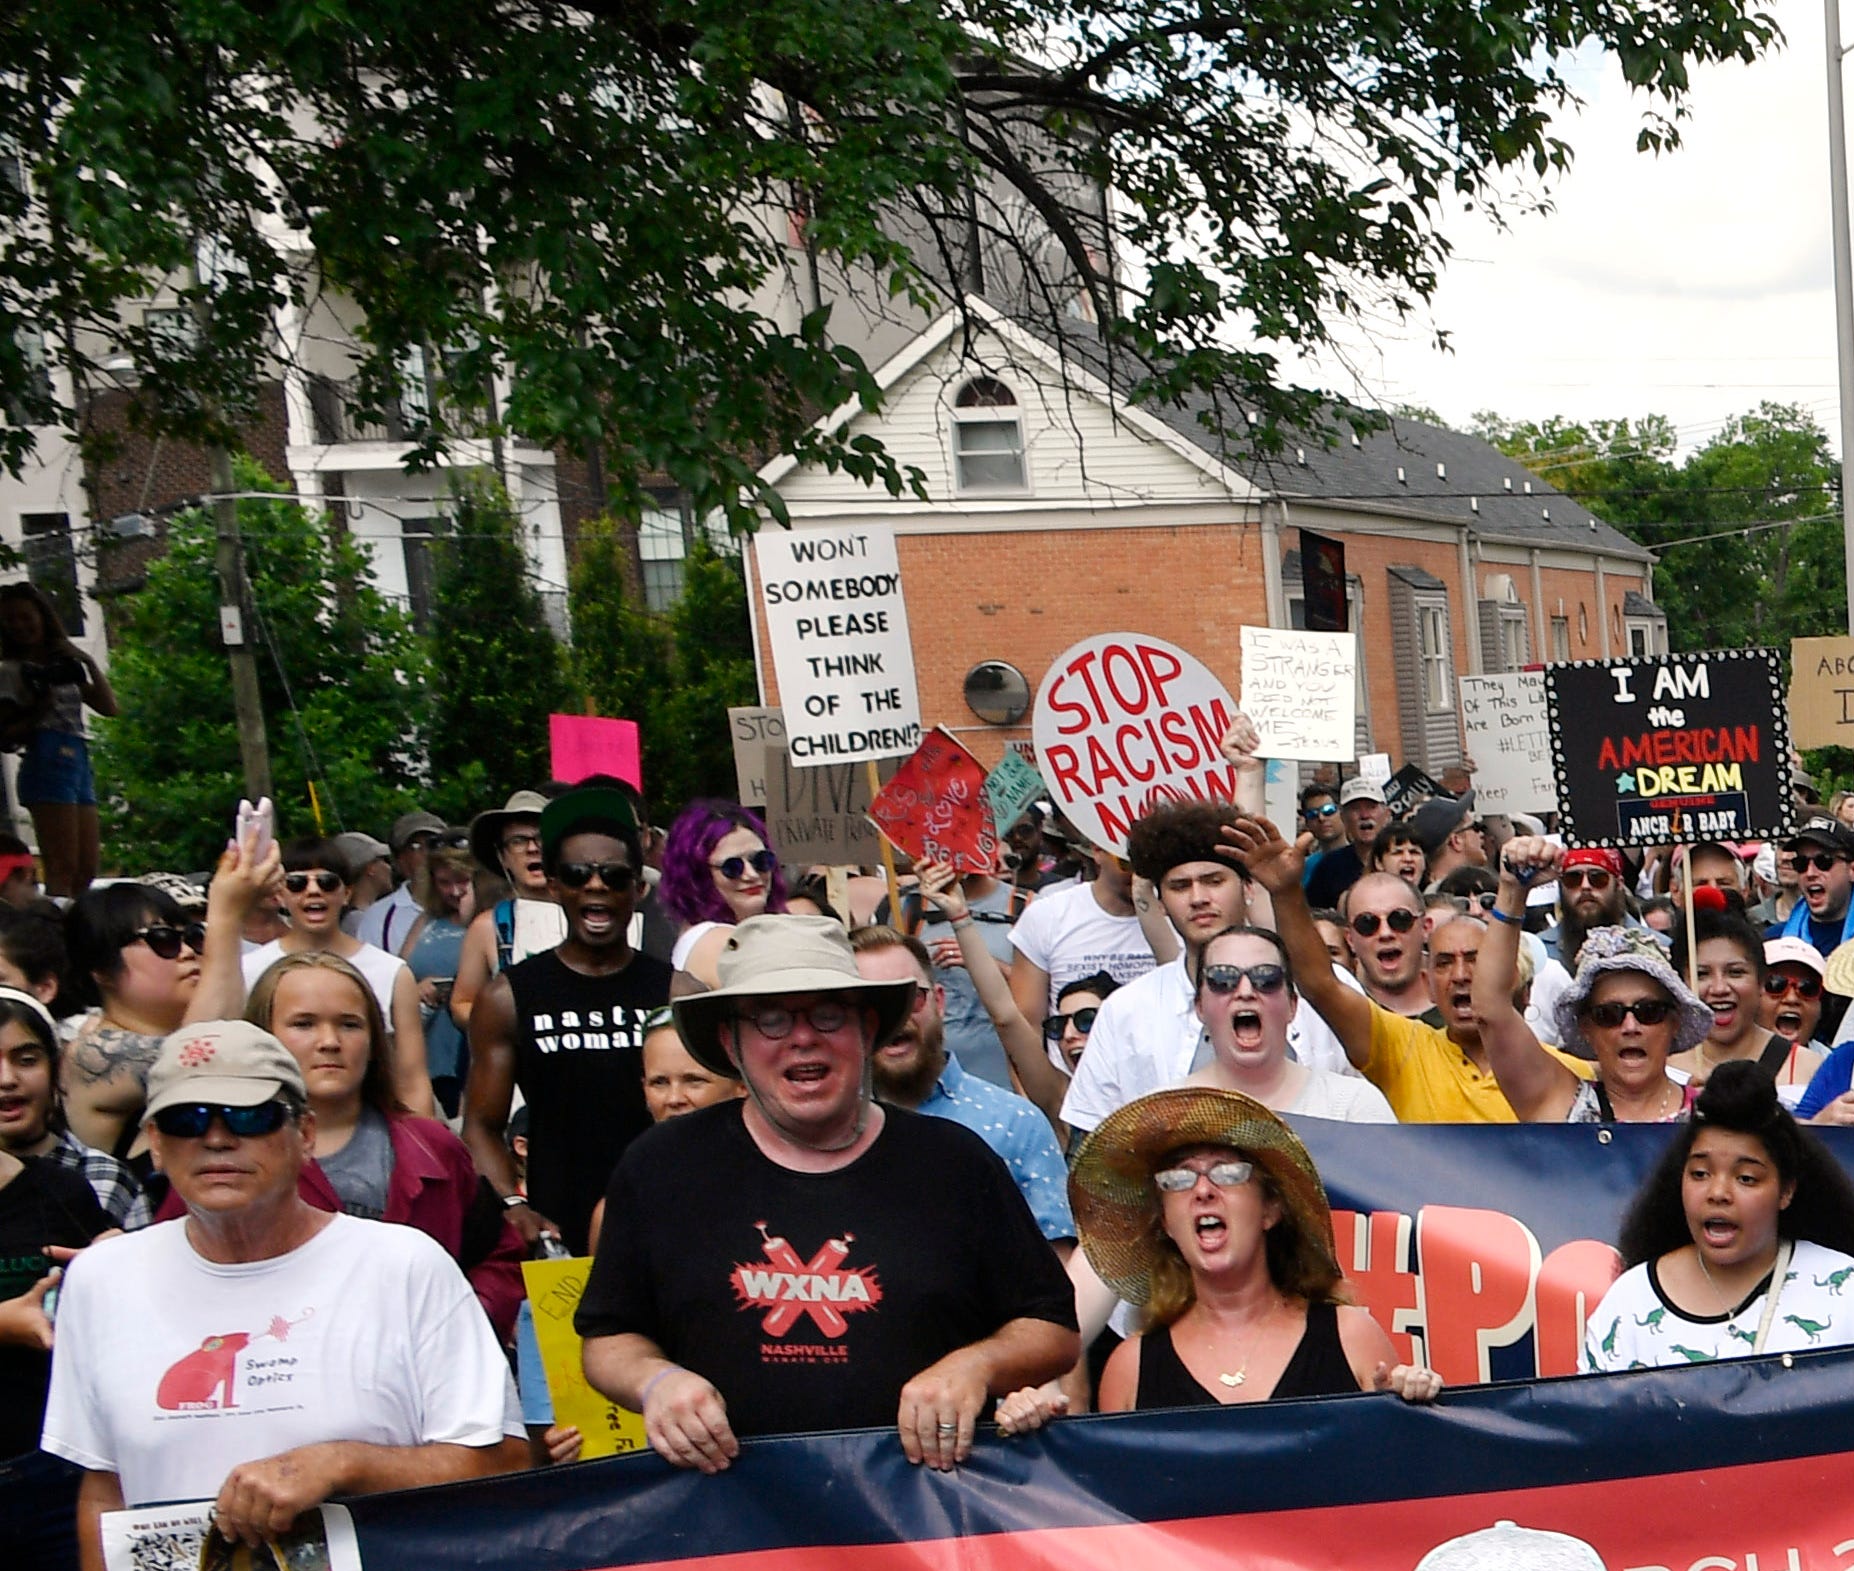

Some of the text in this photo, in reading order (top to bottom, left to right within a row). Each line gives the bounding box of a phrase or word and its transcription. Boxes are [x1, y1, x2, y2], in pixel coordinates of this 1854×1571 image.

[766, 574, 899, 604] SOMEBODY
[796, 611, 889, 639] PLEASE
[1250, 634, 1342, 656] I WAS A
[807, 653, 883, 678] THINK
[1250, 653, 1355, 679] STRANGER
[1048, 644, 1182, 735] STOP
[1248, 677, 1336, 692] AND YOU
[1463, 678, 1505, 698] They
[1610, 663, 1710, 703] I AM
[804, 688, 902, 716] OF THE
[1250, 705, 1339, 721] WELCOME
[1464, 699, 1481, 713] Of
[1487, 698, 1518, 709] This
[736, 716, 786, 741] STO
[1466, 720, 1488, 731] Are
[1501, 713, 1534, 728] Born
[1647, 705, 1686, 728] the
[791, 723, 921, 757] CHILDREN!?
[1044, 698, 1231, 804] RACISM
[1598, 724, 1760, 770] AMERICAN
[1635, 762, 1744, 797] DREAM
[1477, 784, 1508, 801] Keep
[1698, 810, 1737, 832] BABY
[538, 1275, 584, 1320] END
[739, 1269, 870, 1302] WXNA
[761, 1344, 848, 1356] NASHVILLE
[245, 1357, 298, 1370] Swamp
